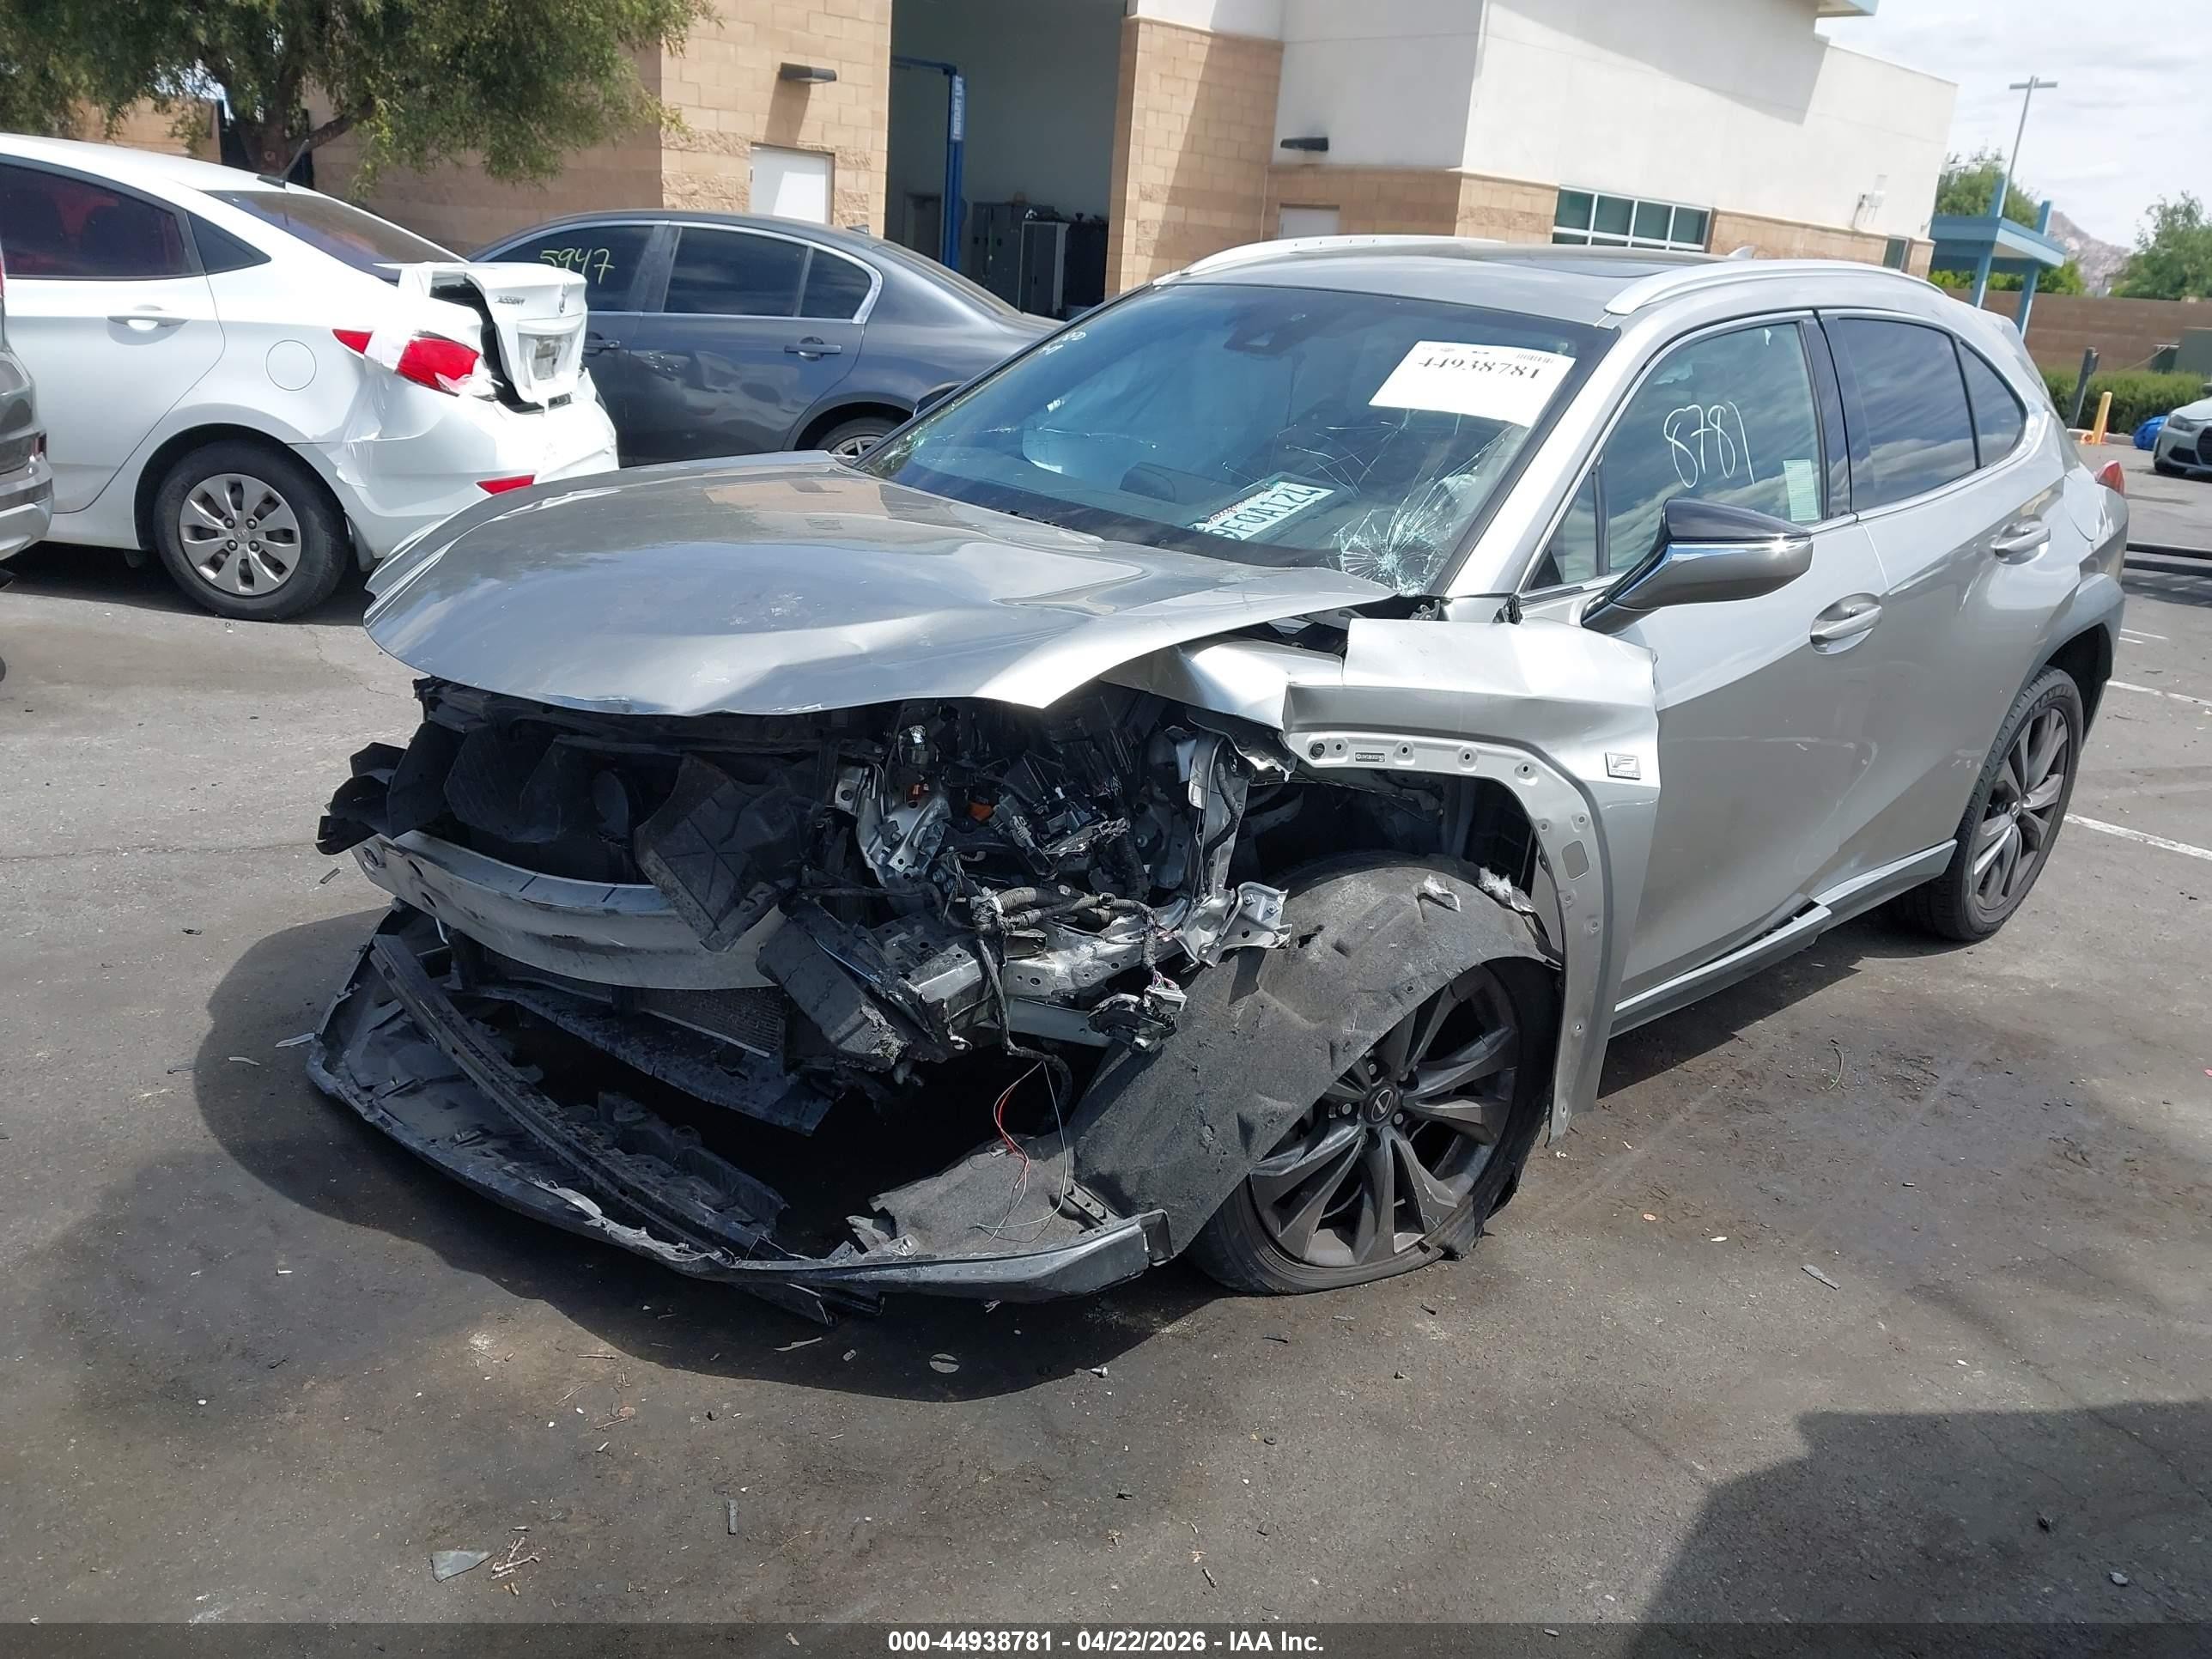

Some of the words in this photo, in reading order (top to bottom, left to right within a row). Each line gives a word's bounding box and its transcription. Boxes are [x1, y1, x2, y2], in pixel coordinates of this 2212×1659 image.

[539, 248, 616, 285] 5947
[1418, 356, 1540, 380] 44938781
[1663, 401, 1755, 489] 8781
